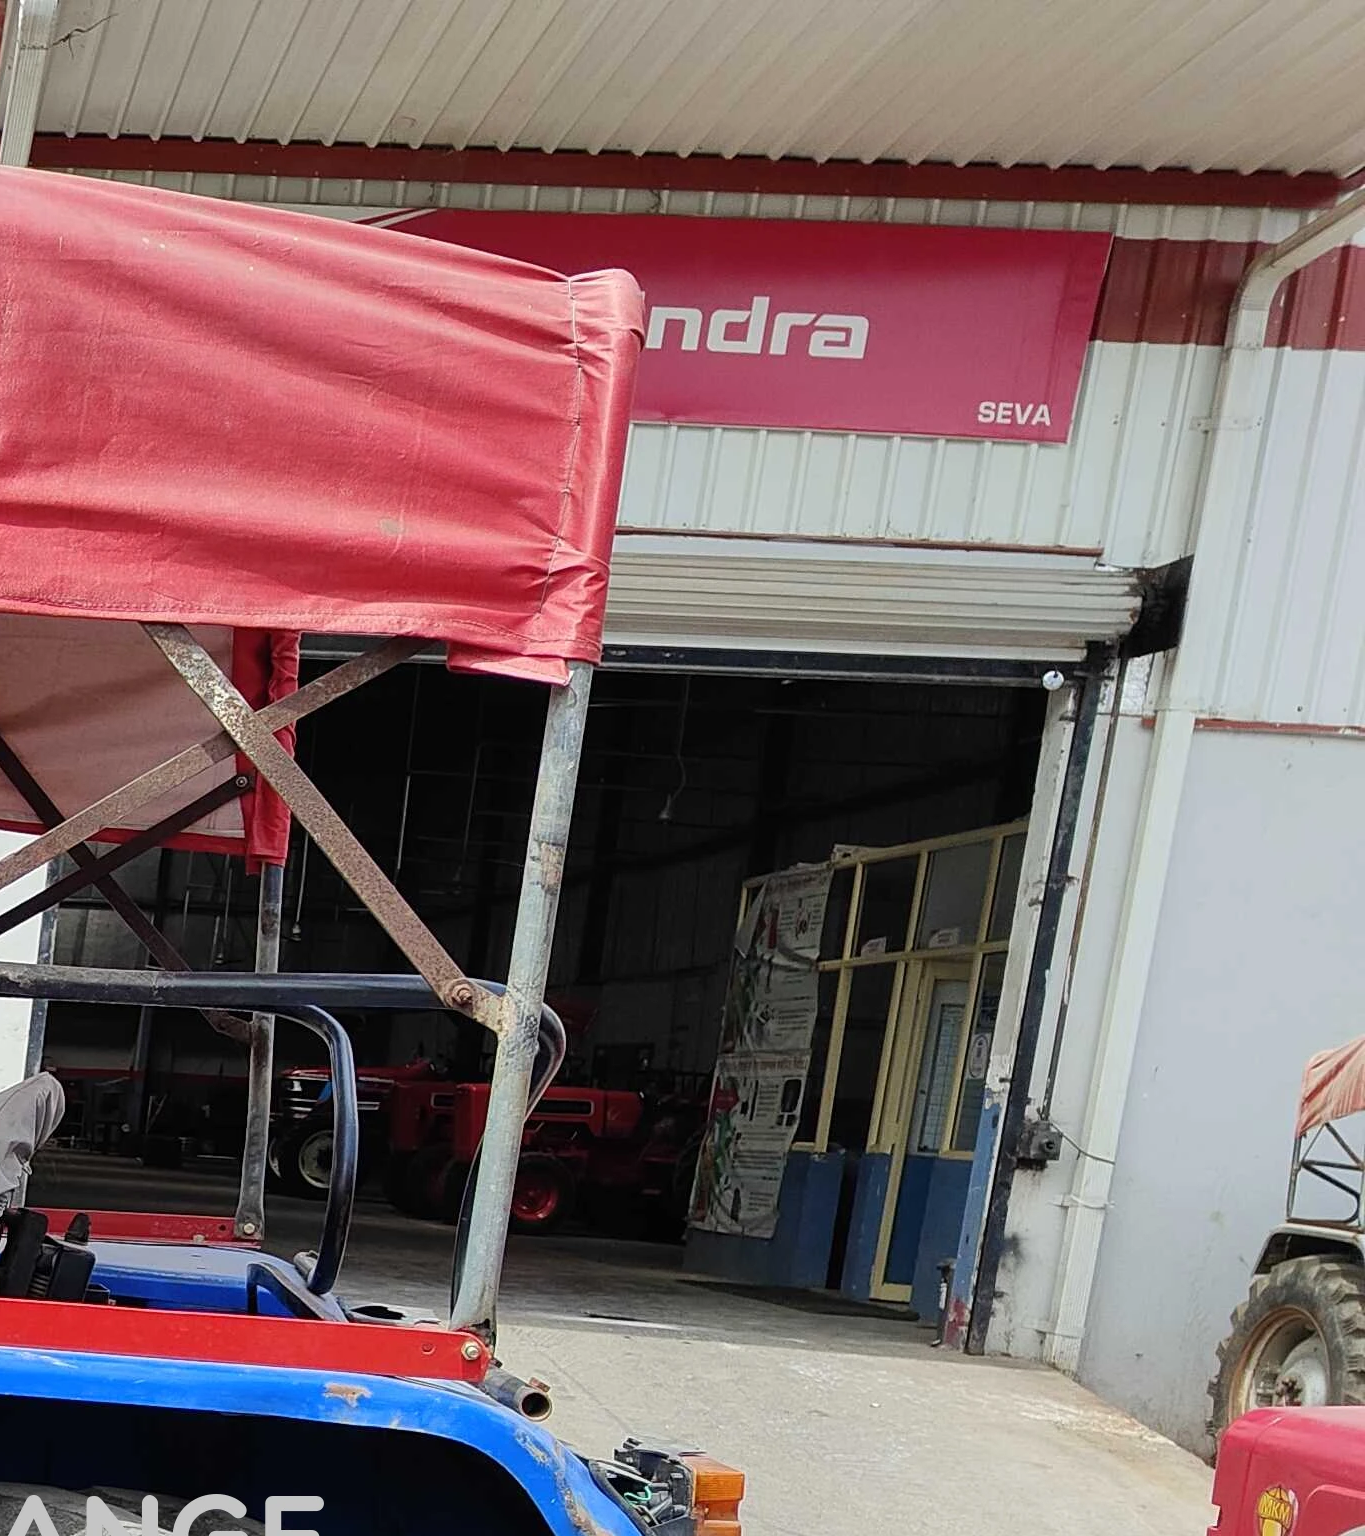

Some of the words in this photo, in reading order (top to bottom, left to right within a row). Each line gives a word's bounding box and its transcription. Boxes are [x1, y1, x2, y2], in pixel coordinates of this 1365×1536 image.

[643, 294, 869, 360] ndra
[977, 400, 1052, 427] SEVA
[1259, 1496, 1292, 1523] MKM
